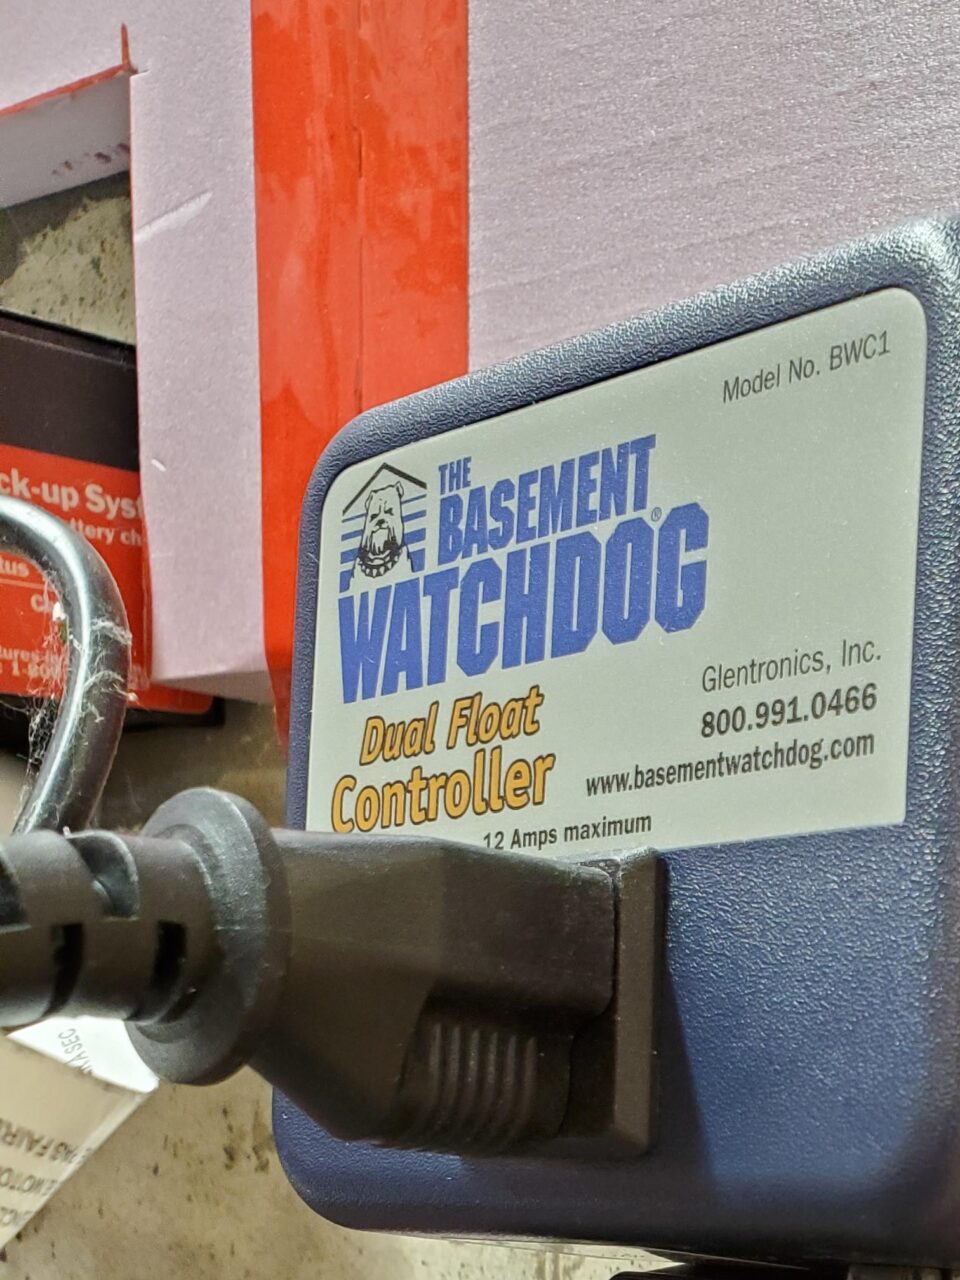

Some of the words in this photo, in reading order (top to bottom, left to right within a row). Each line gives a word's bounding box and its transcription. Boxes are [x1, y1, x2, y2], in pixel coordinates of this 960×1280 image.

[723, 364, 781, 403] Model
[789, 357, 820, 384] No.
[829, 331, 890, 371] BWC1
[437, 433, 656, 567] BASEMENT
[438, 456, 472, 495] THE
[338, 502, 709, 704] WATCHDOG
[702, 649, 832, 692] Glentronics,
[841, 639, 882, 667] Inc.
[359, 701, 440, 766] Dual
[446, 685, 545, 750] Float
[700, 682, 878, 738] 800.991.0466
[331, 745, 556, 834] Controller
[586, 733, 876, 797] www.basementwatchdog.com
[483, 833, 504, 851] 12
[510, 826, 558, 851] Amps
[563, 814, 652, 844] maximum
